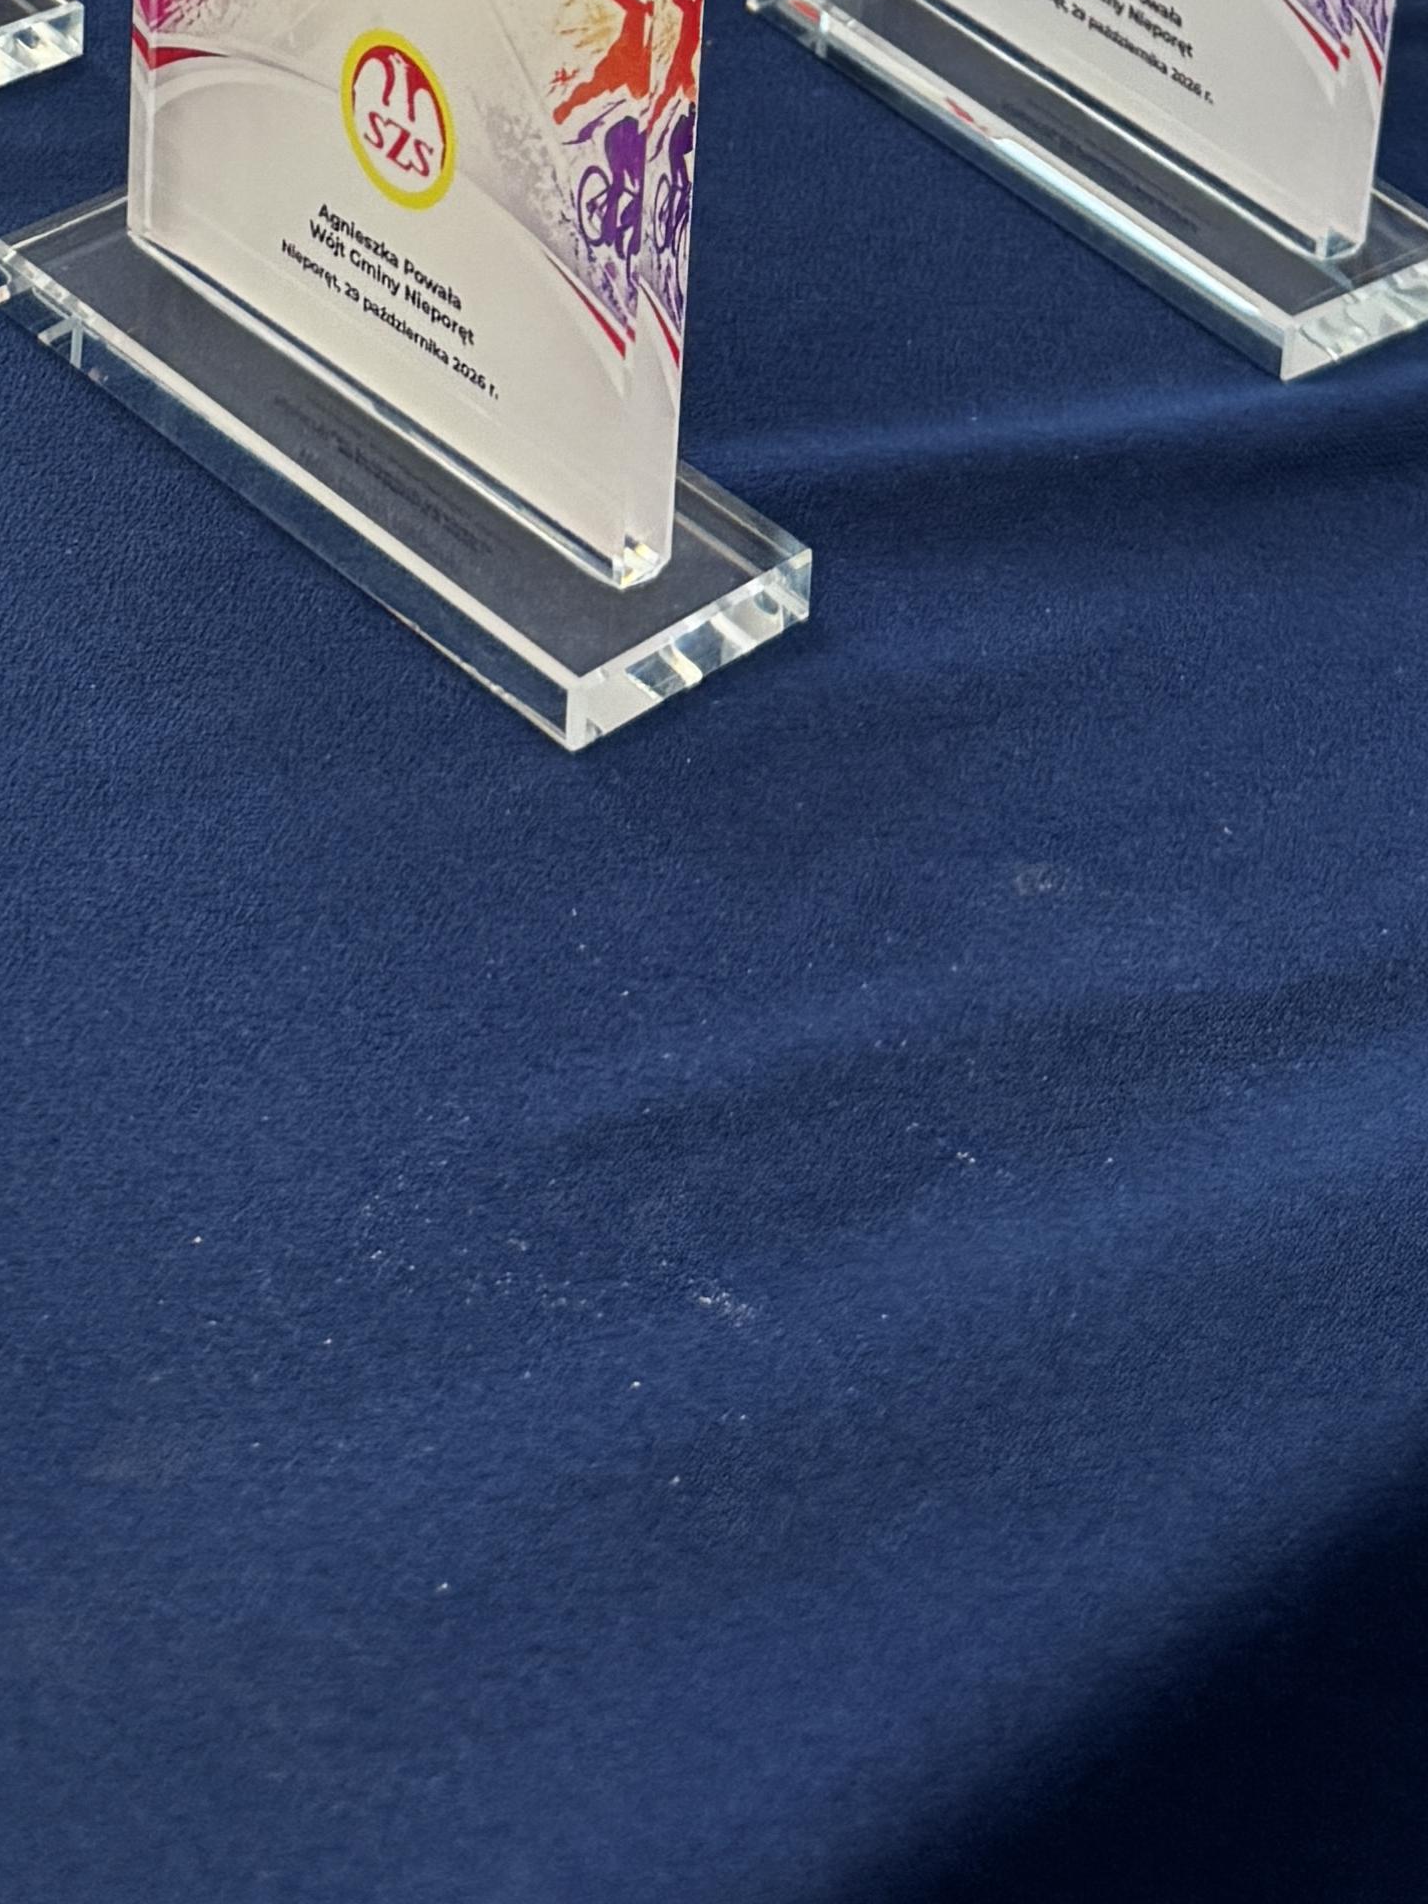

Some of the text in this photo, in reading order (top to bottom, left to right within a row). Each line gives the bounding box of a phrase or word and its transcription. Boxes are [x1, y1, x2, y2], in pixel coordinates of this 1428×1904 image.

[362, 111, 434, 177] SZS
[309, 220, 475, 345] Wójt Gminy Nieporęt
[318, 205, 462, 310] Agnieszka Powała
[344, 282, 360, 302] 29
[362, 297, 450, 365] października
[452, 357, 487, 389] 2026
